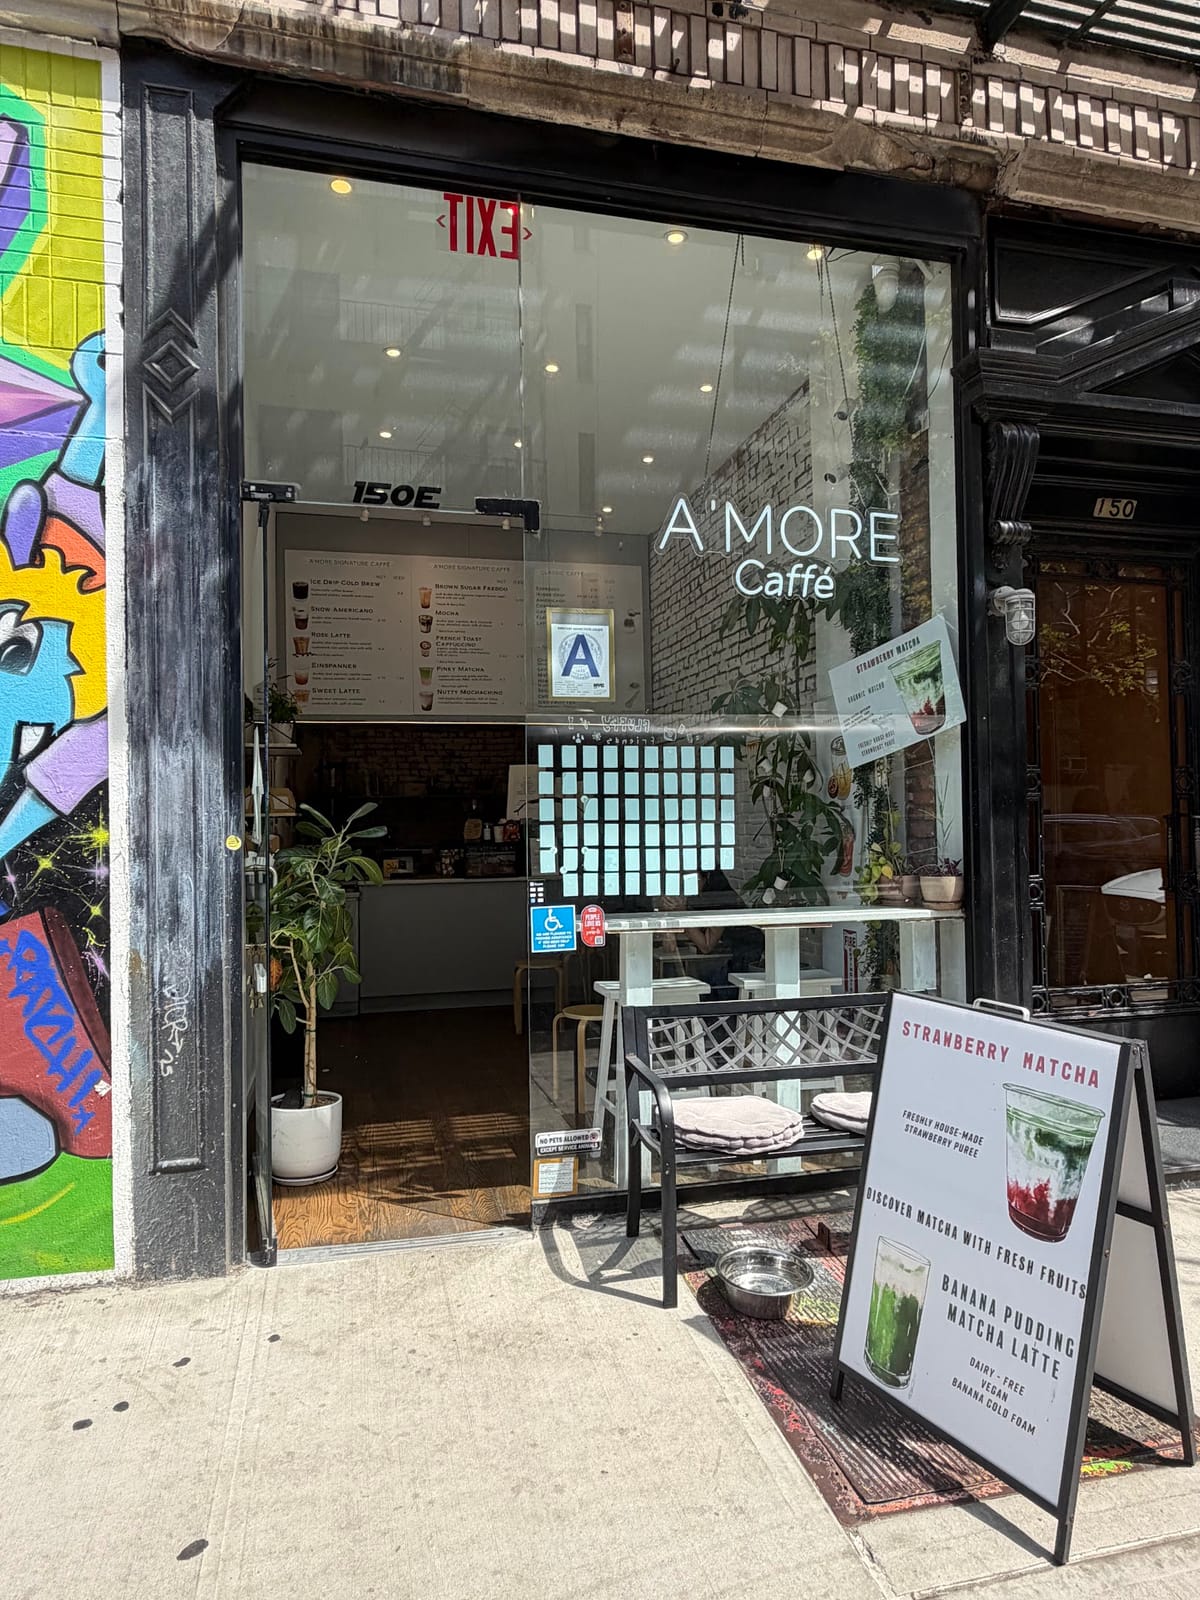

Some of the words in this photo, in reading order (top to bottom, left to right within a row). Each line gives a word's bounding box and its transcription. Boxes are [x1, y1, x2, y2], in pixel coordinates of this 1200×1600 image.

[352, 481, 442, 509] 150E
[1097, 499, 1134, 518] 150
[659, 498, 900, 562] A'MORE
[735, 559, 834, 599] Caffé
[561, 634, 600, 677] A
[856, 648, 895, 674] STRAWBERRY
[895, 636, 921, 654] MATCHA
[902, 1020, 1010, 1063] STRAWBERRY
[1022, 1052, 1099, 1088] MATCHA
[549, 1136, 563, 1144] PETS
[564, 1134, 589, 1142] ALLOWED
[902, 1109, 933, 1128] FRESHLY
[934, 1121, 984, 1146] HOUSE-MADE
[904, 1123, 952, 1148] STRAWBERRY
[953, 1141, 979, 1158] PUREE
[540, 1145, 557, 1153] EXCEPT
[558, 1144, 577, 1152] SERVICE
[867, 1187, 913, 1219] DISCOVER
[916, 1209, 958, 1240] MATCHA
[963, 1229, 992, 1256] WITH
[996, 1246, 1034, 1275] FRESH
[1039, 1266, 1087, 1300] FRUITS
[942, 1274, 997, 1318] BANANA
[1003, 1305, 1075, 1359] PUDDING
[947, 1303, 1004, 1349] MATCHA
[1011, 1338, 1061, 1380] LATTE
[969, 1357, 995, 1378] DAIRY
[1003, 1376, 1026, 1396] FREE
[981, 1378, 1008, 1402] VEGAN
[951, 1377, 984, 1403] BANANA
[986, 1397, 1008, 1419] COLD
[1011, 1413, 1036, 1436] FOAM
